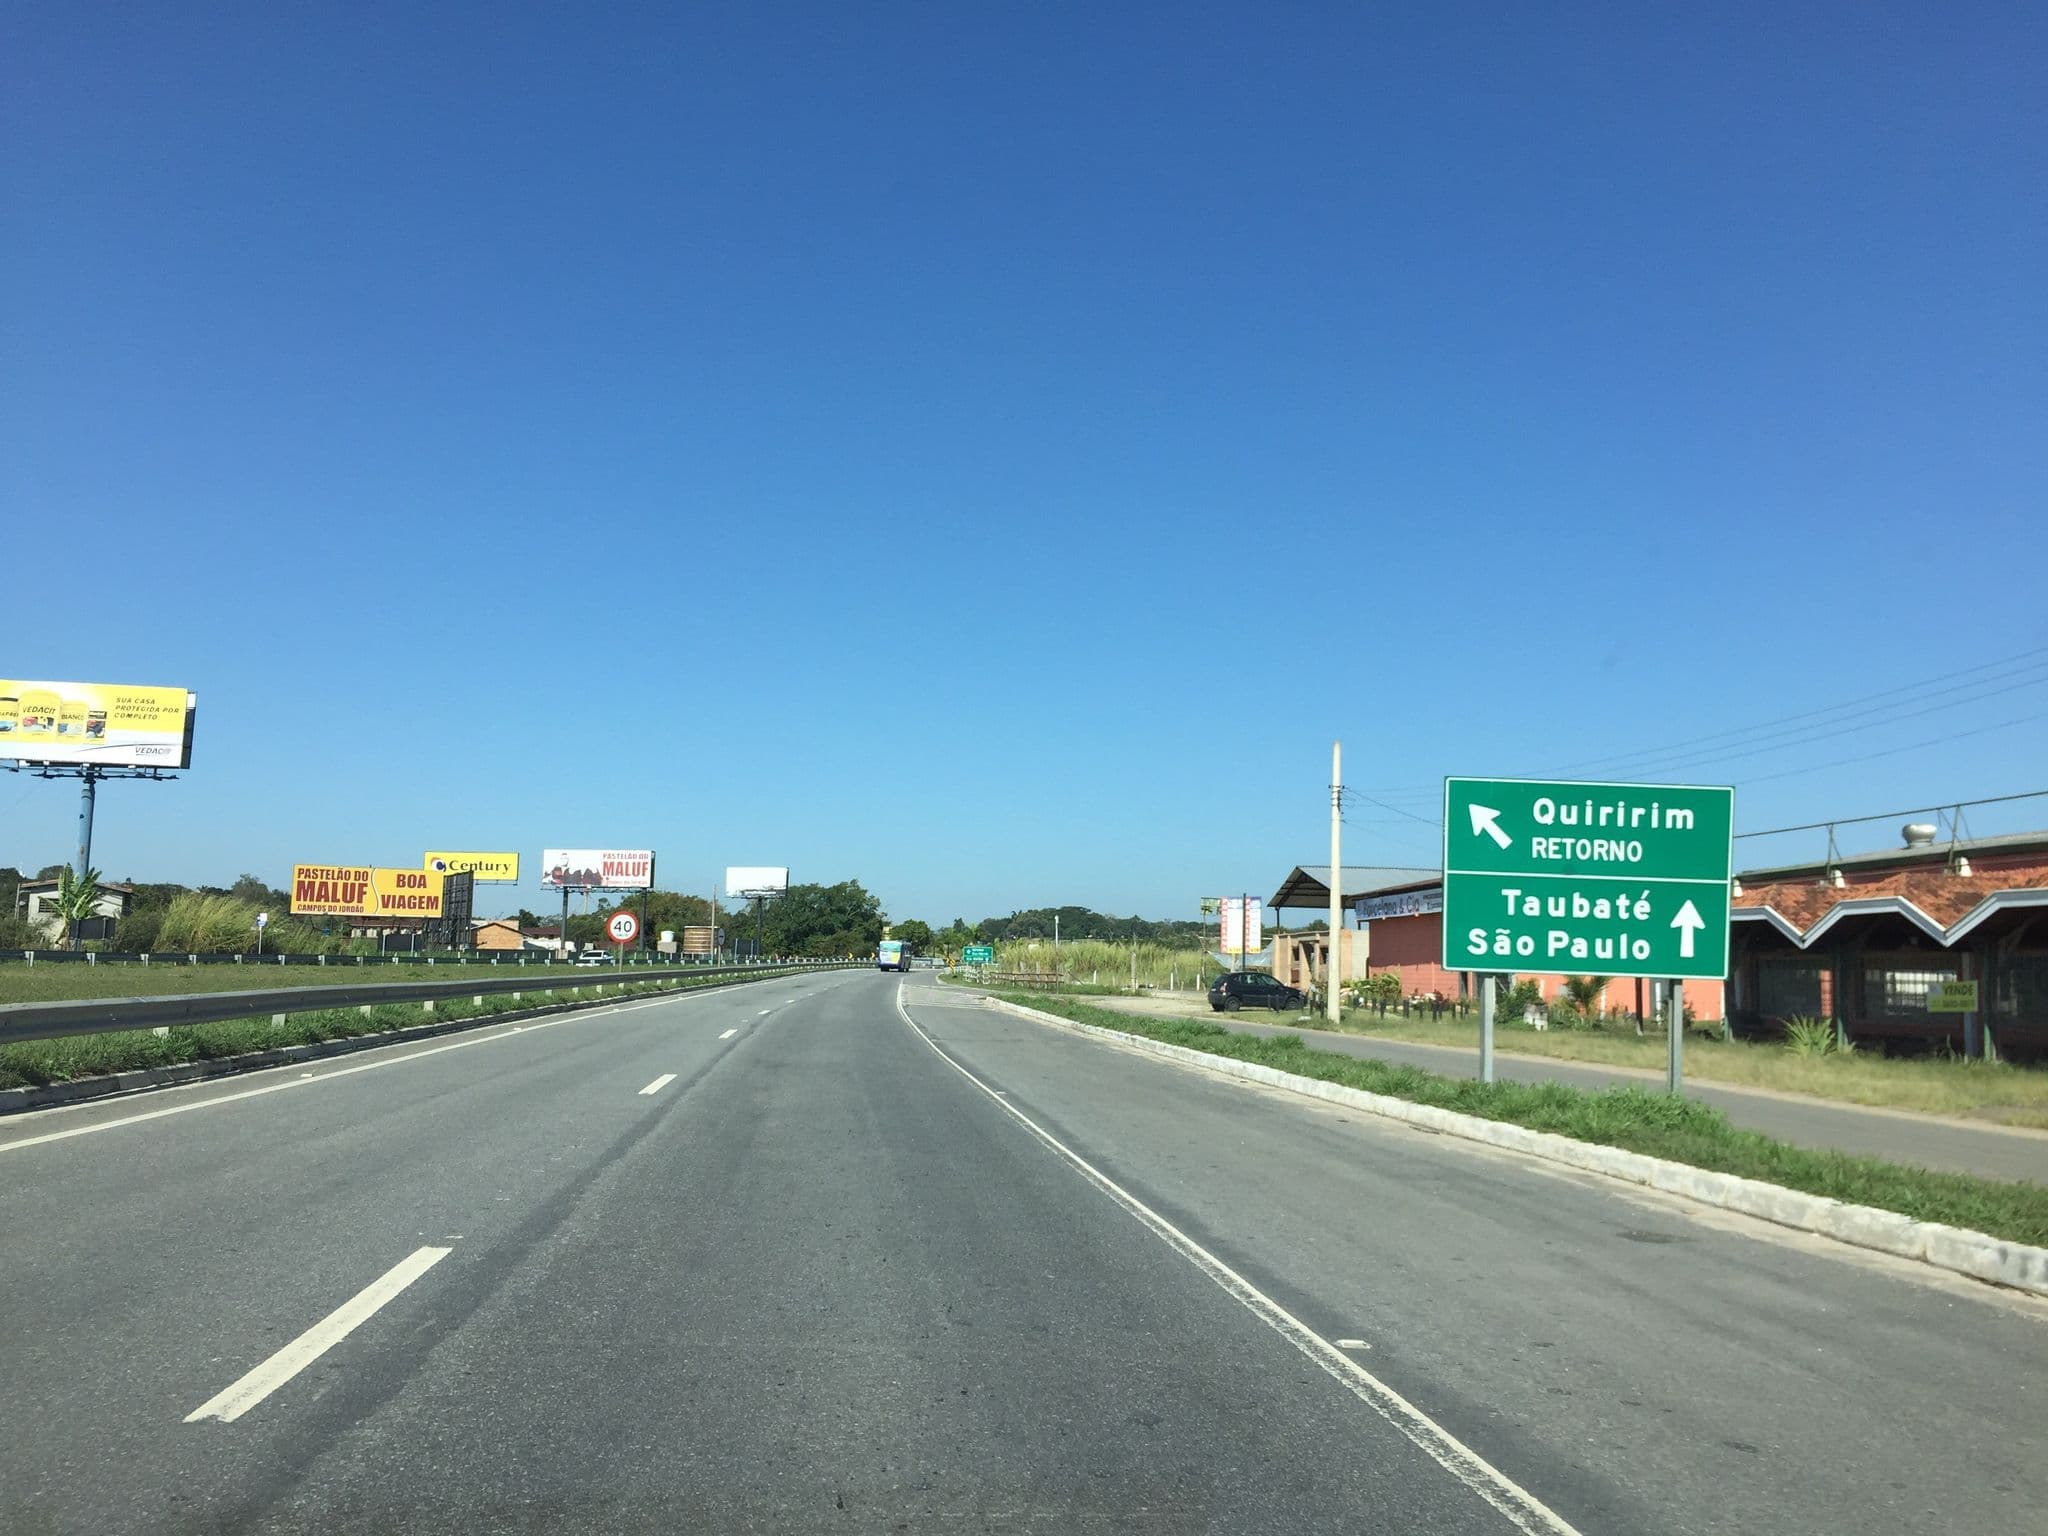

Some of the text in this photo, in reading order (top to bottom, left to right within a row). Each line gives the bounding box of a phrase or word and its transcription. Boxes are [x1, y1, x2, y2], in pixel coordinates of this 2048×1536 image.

[22, 705, 56, 715] VEDACIT
[114, 712, 158, 720] COMPLETO
[115, 704, 160, 713] PROTEGIDA
[1533, 797, 1695, 830] Quiririm
[1531, 837, 1644, 863] RETORNO
[448, 859, 512, 873] Century
[602, 861, 649, 877] MALUF
[297, 867, 369, 882] PASTELÃO DO
[396, 873, 427, 889] BOA
[295, 879, 368, 904] MALUF
[297, 904, 326, 912] CAMPOS
[327, 905, 338, 913] DO
[381, 894, 439, 912] VIAGEM
[1501, 888, 1652, 920] Taubaté
[614, 920, 632, 933] 40
[1466, 927, 1651, 961] São Paulo
